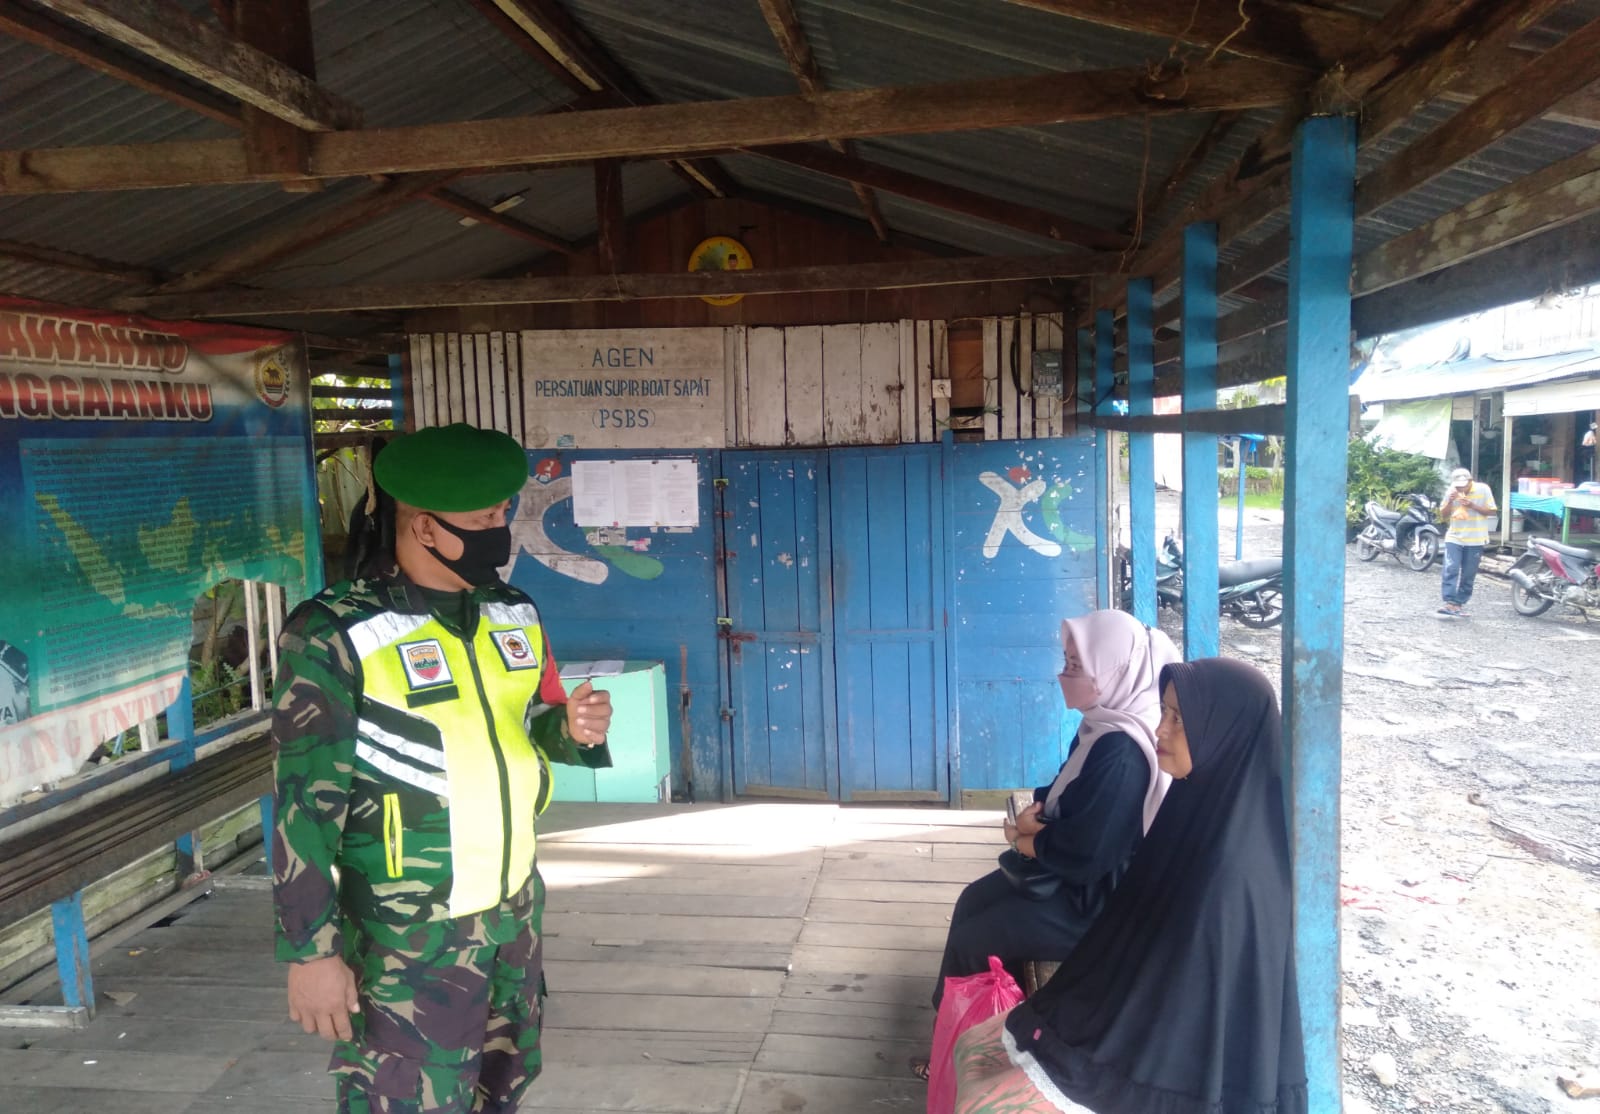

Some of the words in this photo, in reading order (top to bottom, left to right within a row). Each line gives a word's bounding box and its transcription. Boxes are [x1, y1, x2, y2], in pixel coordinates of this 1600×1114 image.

[591, 347, 654, 368] AGEN
[535, 379, 602, 397] PERSATUAN
[604, 380, 640, 397] SUPIR
[641, 379, 671, 396] BOAT
[673, 378, 711, 397] SAPAT
